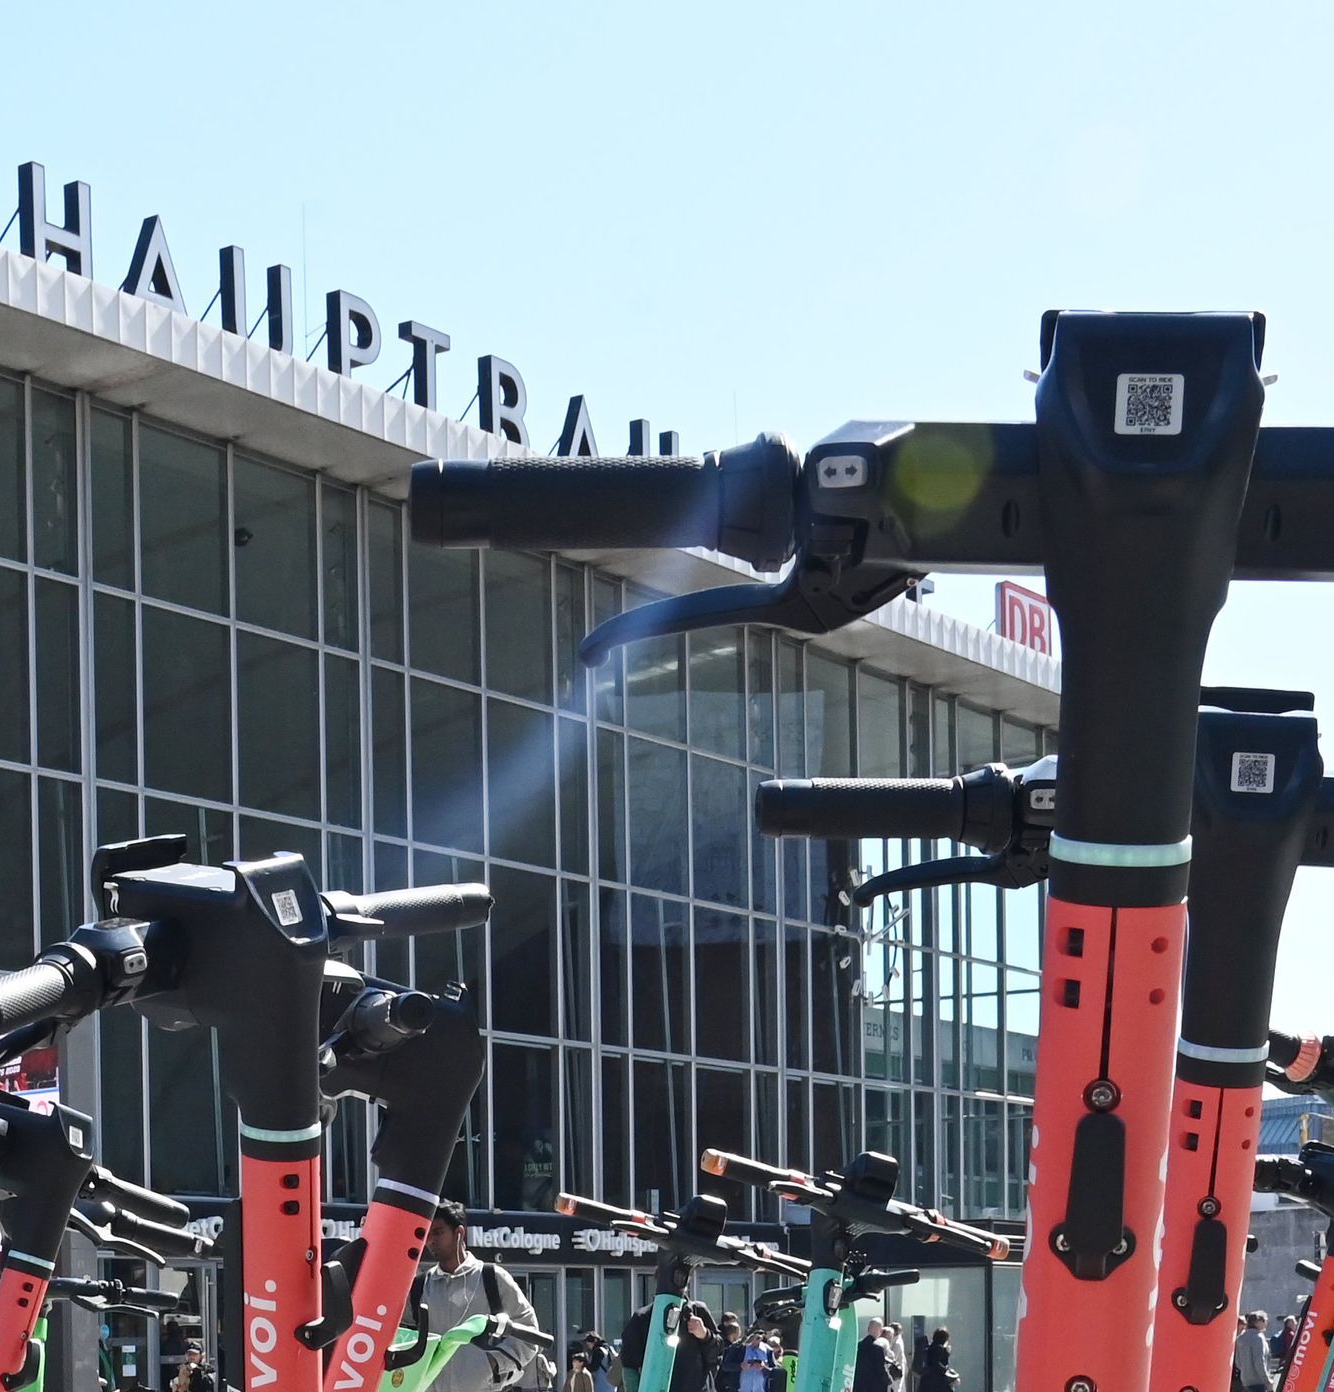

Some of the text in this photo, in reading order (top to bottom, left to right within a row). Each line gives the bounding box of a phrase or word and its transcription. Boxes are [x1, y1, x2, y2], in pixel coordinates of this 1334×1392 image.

[468, 1225, 561, 1256] NetCologne
[244, 1279, 277, 1388] voi.
[333, 1304, 387, 1391] voi.
